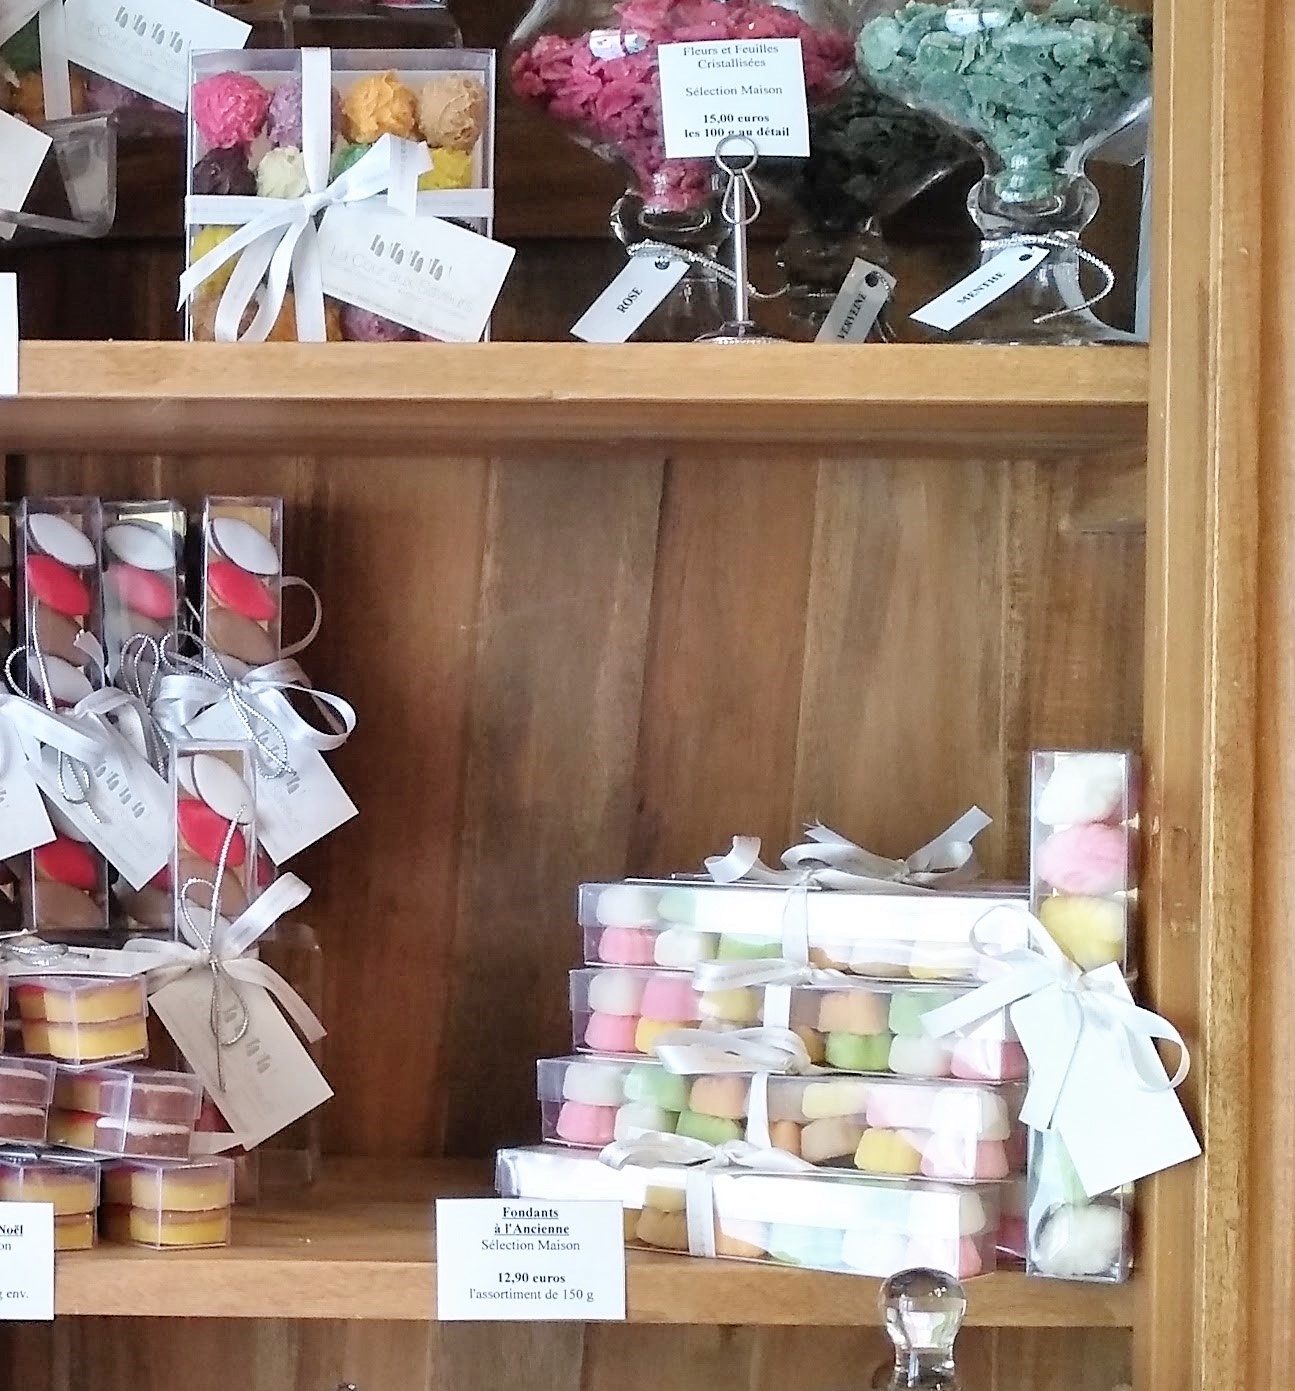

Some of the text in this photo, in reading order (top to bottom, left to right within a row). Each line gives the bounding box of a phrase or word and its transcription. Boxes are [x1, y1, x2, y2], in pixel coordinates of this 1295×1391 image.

[684, 44, 779, 56] Fleurs et Feuilles
[698, 57, 766, 68] Cristallisées
[686, 85, 782, 96] Sélection Maison
[703, 114, 734, 124] 15,00
[684, 129, 700, 138] les
[705, 128, 724, 137] 100
[757, 128, 789, 136] détail
[956, 271, 1005, 304] MENTHE
[616, 286, 642, 313] ROSE
[837, 293, 867, 339] VERVEINE
[503, 1207, 558, 1218] Fondants
[494, 1223, 570, 1234] à l'Ancienne
[482, 1240, 580, 1251] Sélection Maison
[498, 1272, 565, 1283] 12,90 euros
[7, 1290, 29, 1298] env.
[469, 1289, 594, 1302] l'assortiment de 150 g
